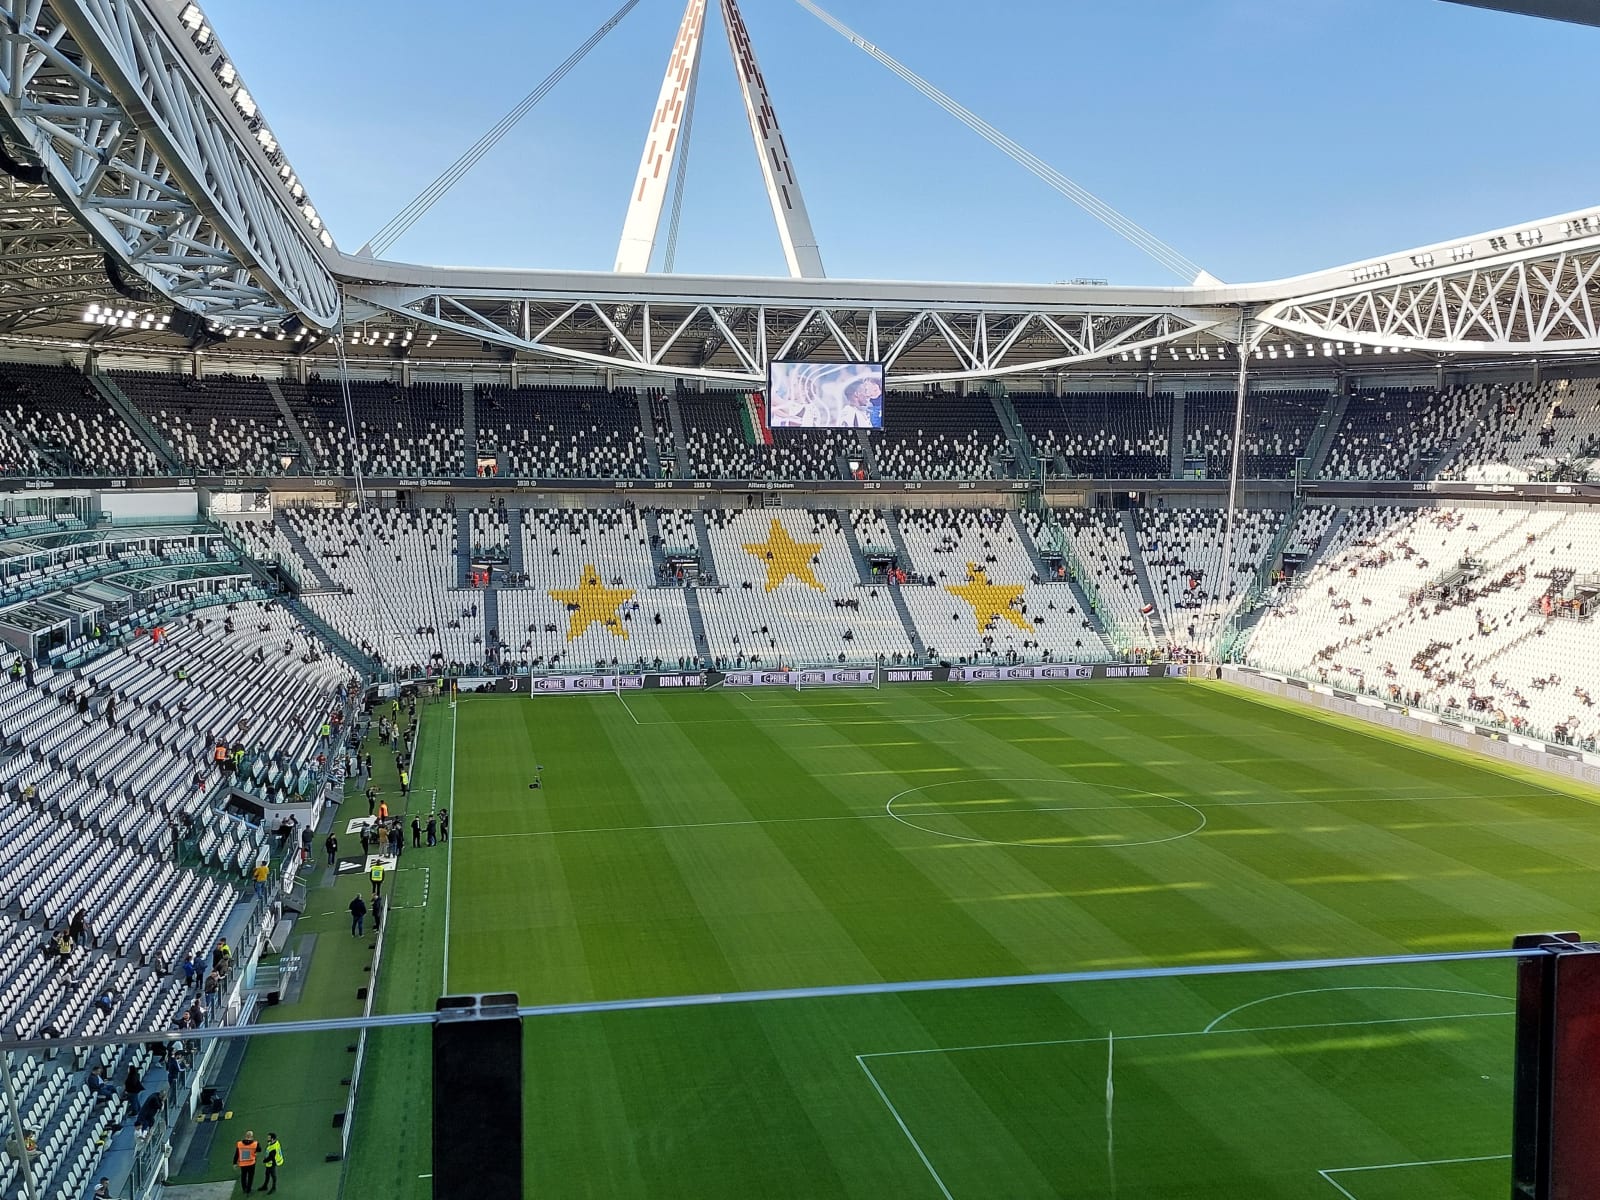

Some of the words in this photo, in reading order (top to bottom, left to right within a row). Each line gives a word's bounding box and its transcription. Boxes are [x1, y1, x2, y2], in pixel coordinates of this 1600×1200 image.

[806, 672, 823, 681] PRIME
[841, 672, 858, 681] PRIME
[887, 671, 910, 681] DRINK
[911, 670, 933, 681] PRIME
[1016, 669, 1032, 677] PRIME
[1050, 669, 1066, 677] PRIME
[1106, 667, 1128, 677] DRINK
[1129, 667, 1150, 677] PRIME
[583, 678, 602, 688] PRIME
[621, 677, 640, 687] PRIME
[659, 676, 684, 687] DRINK
[734, 675, 752, 684] PRIME
[770, 674, 787, 683] PRIME
[544, 679, 563, 688] PRIME
